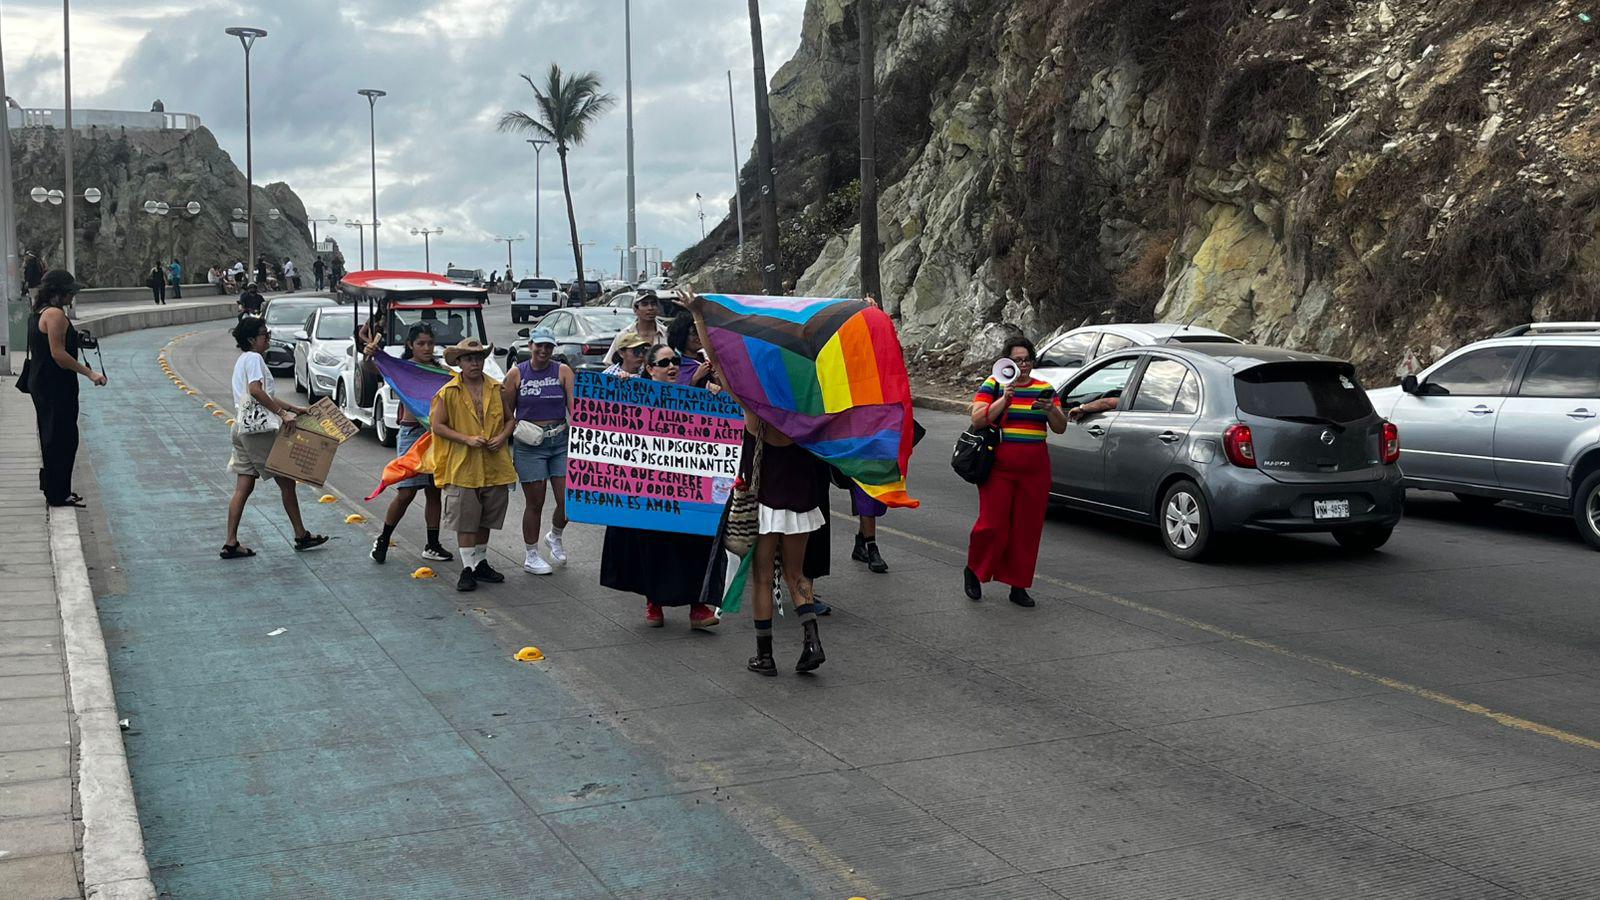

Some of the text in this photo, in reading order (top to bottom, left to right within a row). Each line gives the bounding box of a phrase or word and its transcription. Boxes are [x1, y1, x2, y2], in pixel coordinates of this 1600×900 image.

[520, 387, 542, 396] Gay
[577, 372, 602, 385] ESTA
[606, 376, 655, 393] PERSONA
[661, 386, 672, 397] ES
[573, 398, 730, 428] PROABORTO Y ALIADE DE LA
[574, 384, 744, 417] TE FEMINISTA ANTIPATRIARCAL
[572, 412, 643, 430] COMUNIDAD
[571, 427, 738, 458] PROPAGANDA NI DISCURSOS DE
[568, 470, 631, 492] VIOLENCIA
[636, 481, 643, 493] U
[677, 486, 704, 500] ESTA
[569, 460, 703, 489] CUAL SEA QUE GENERE
[567, 488, 680, 515] PERSONA ES AMOR
